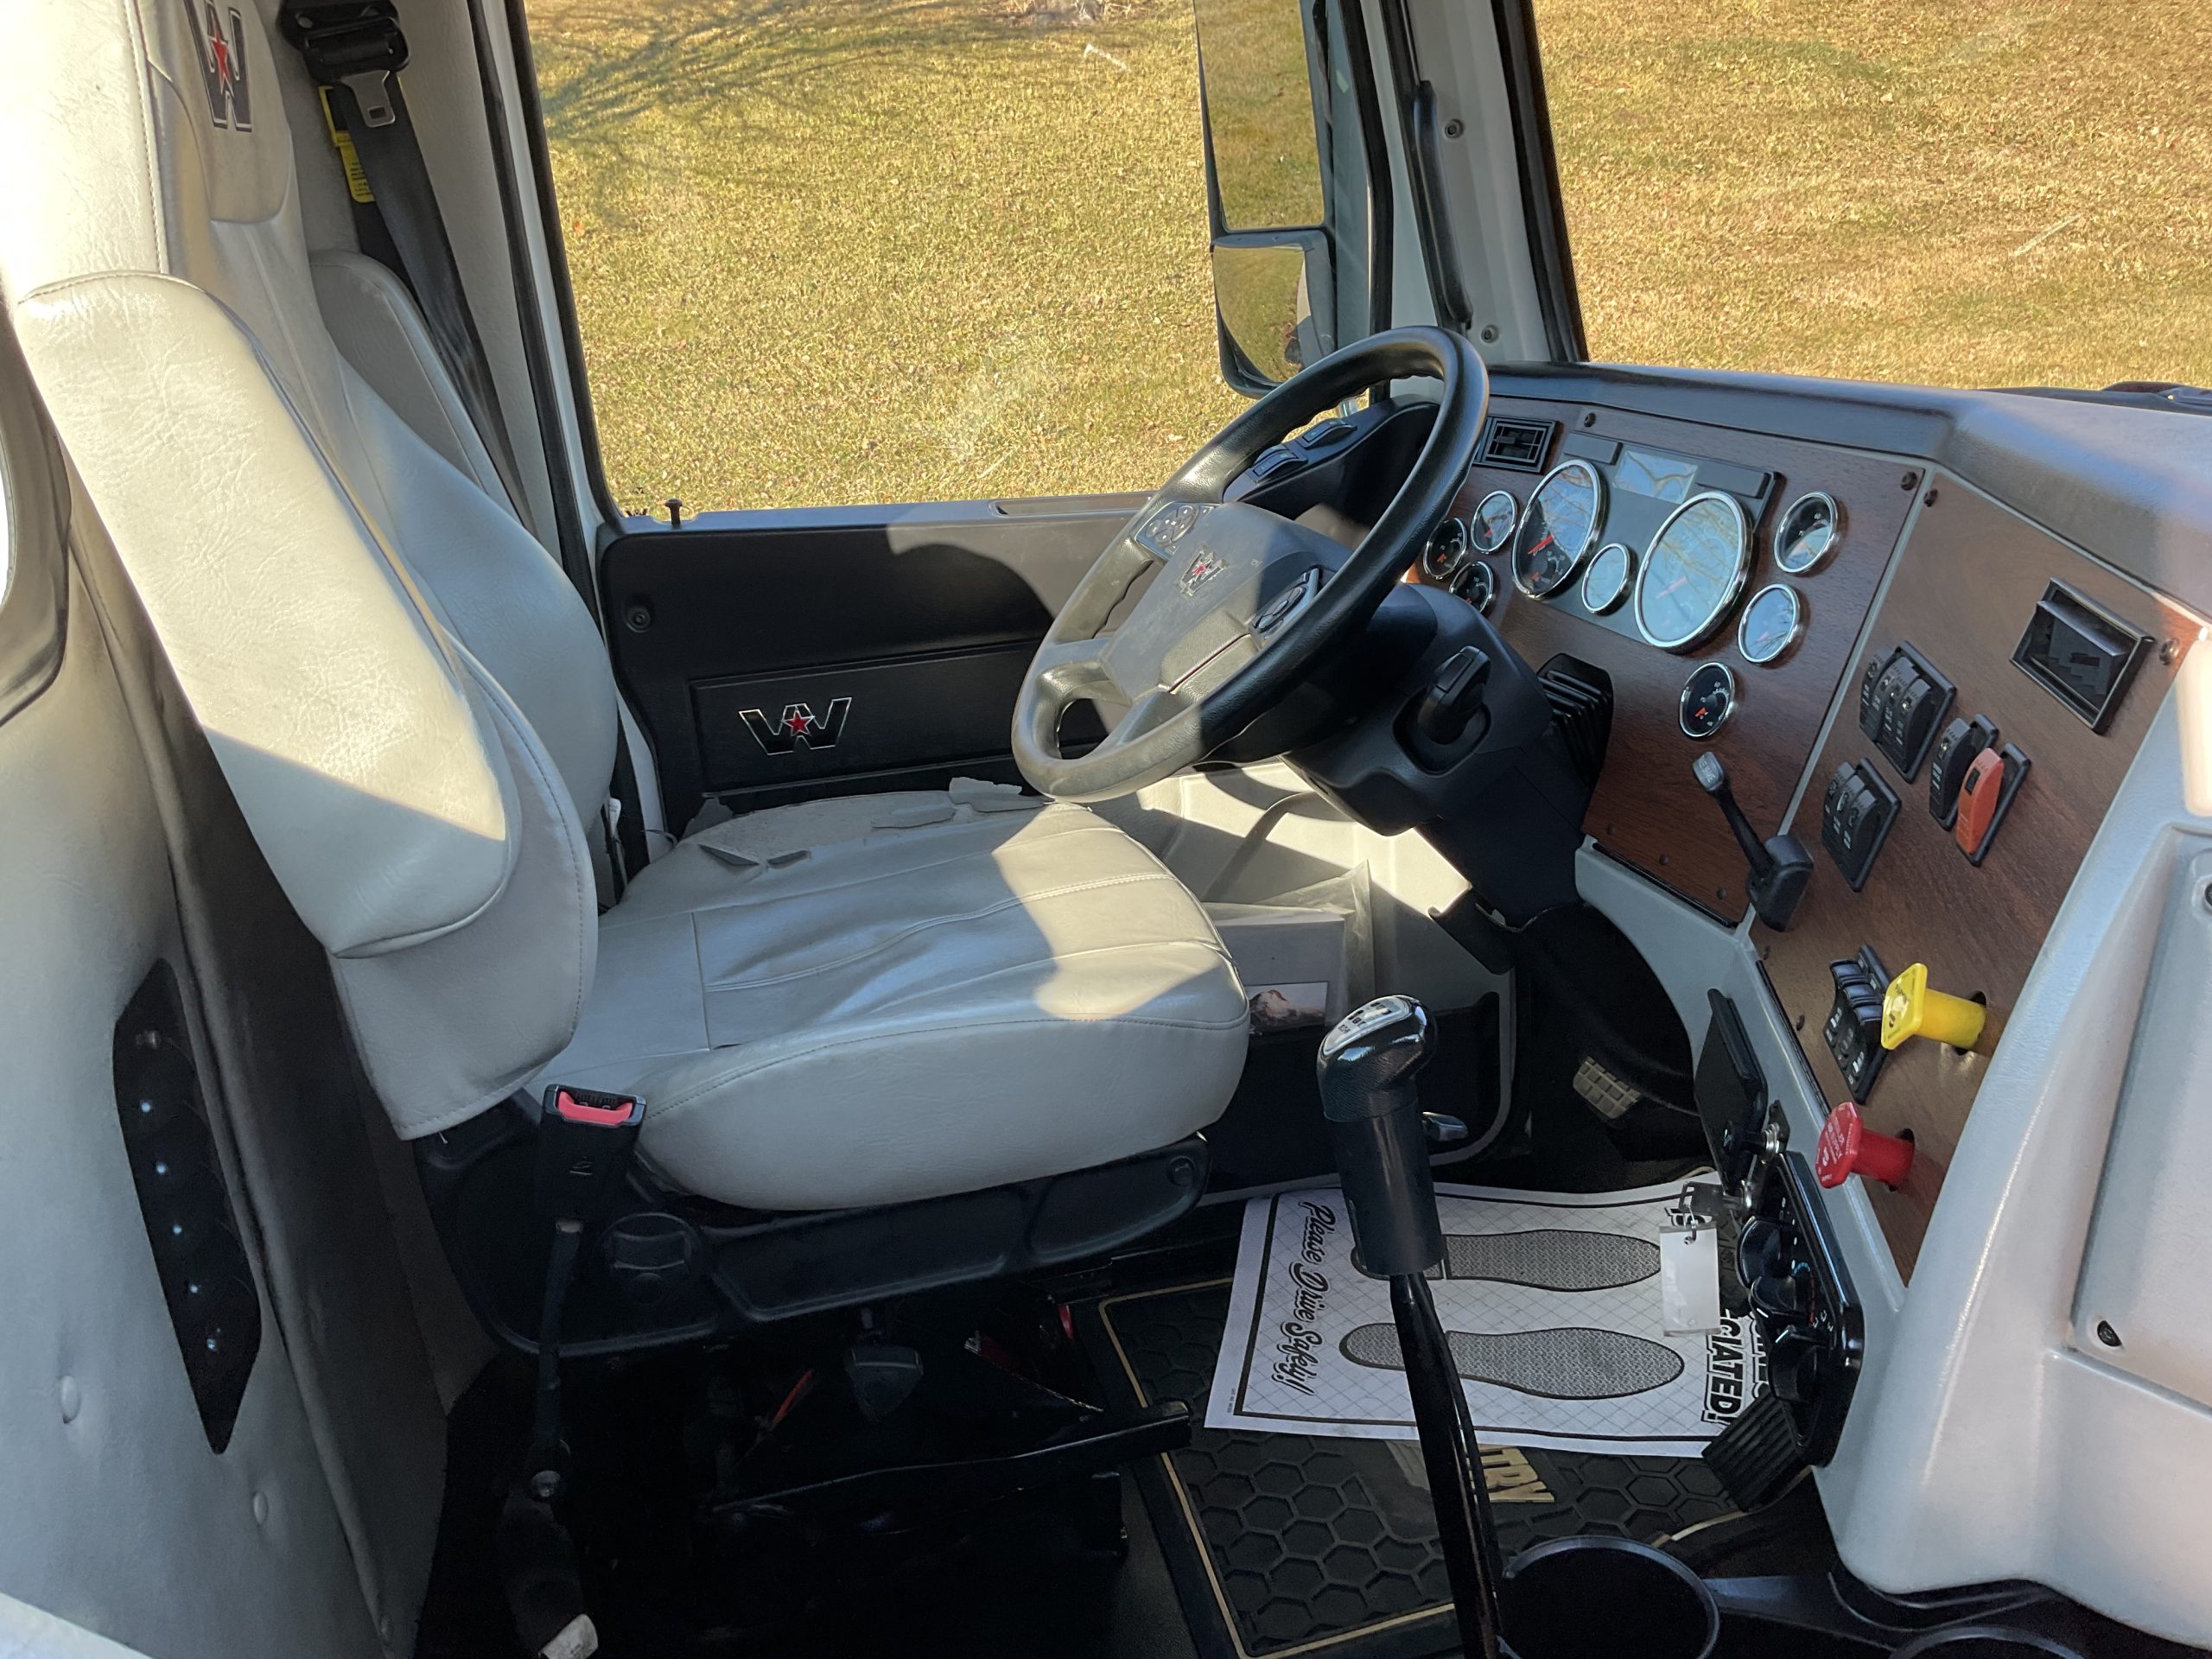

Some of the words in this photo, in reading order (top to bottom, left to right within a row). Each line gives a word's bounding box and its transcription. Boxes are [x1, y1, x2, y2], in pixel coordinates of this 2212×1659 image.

[1298, 1201, 1336, 1265] Please
[1288, 1262, 1329, 1323] Drive
[1271, 1321, 1323, 1395] Safely!
